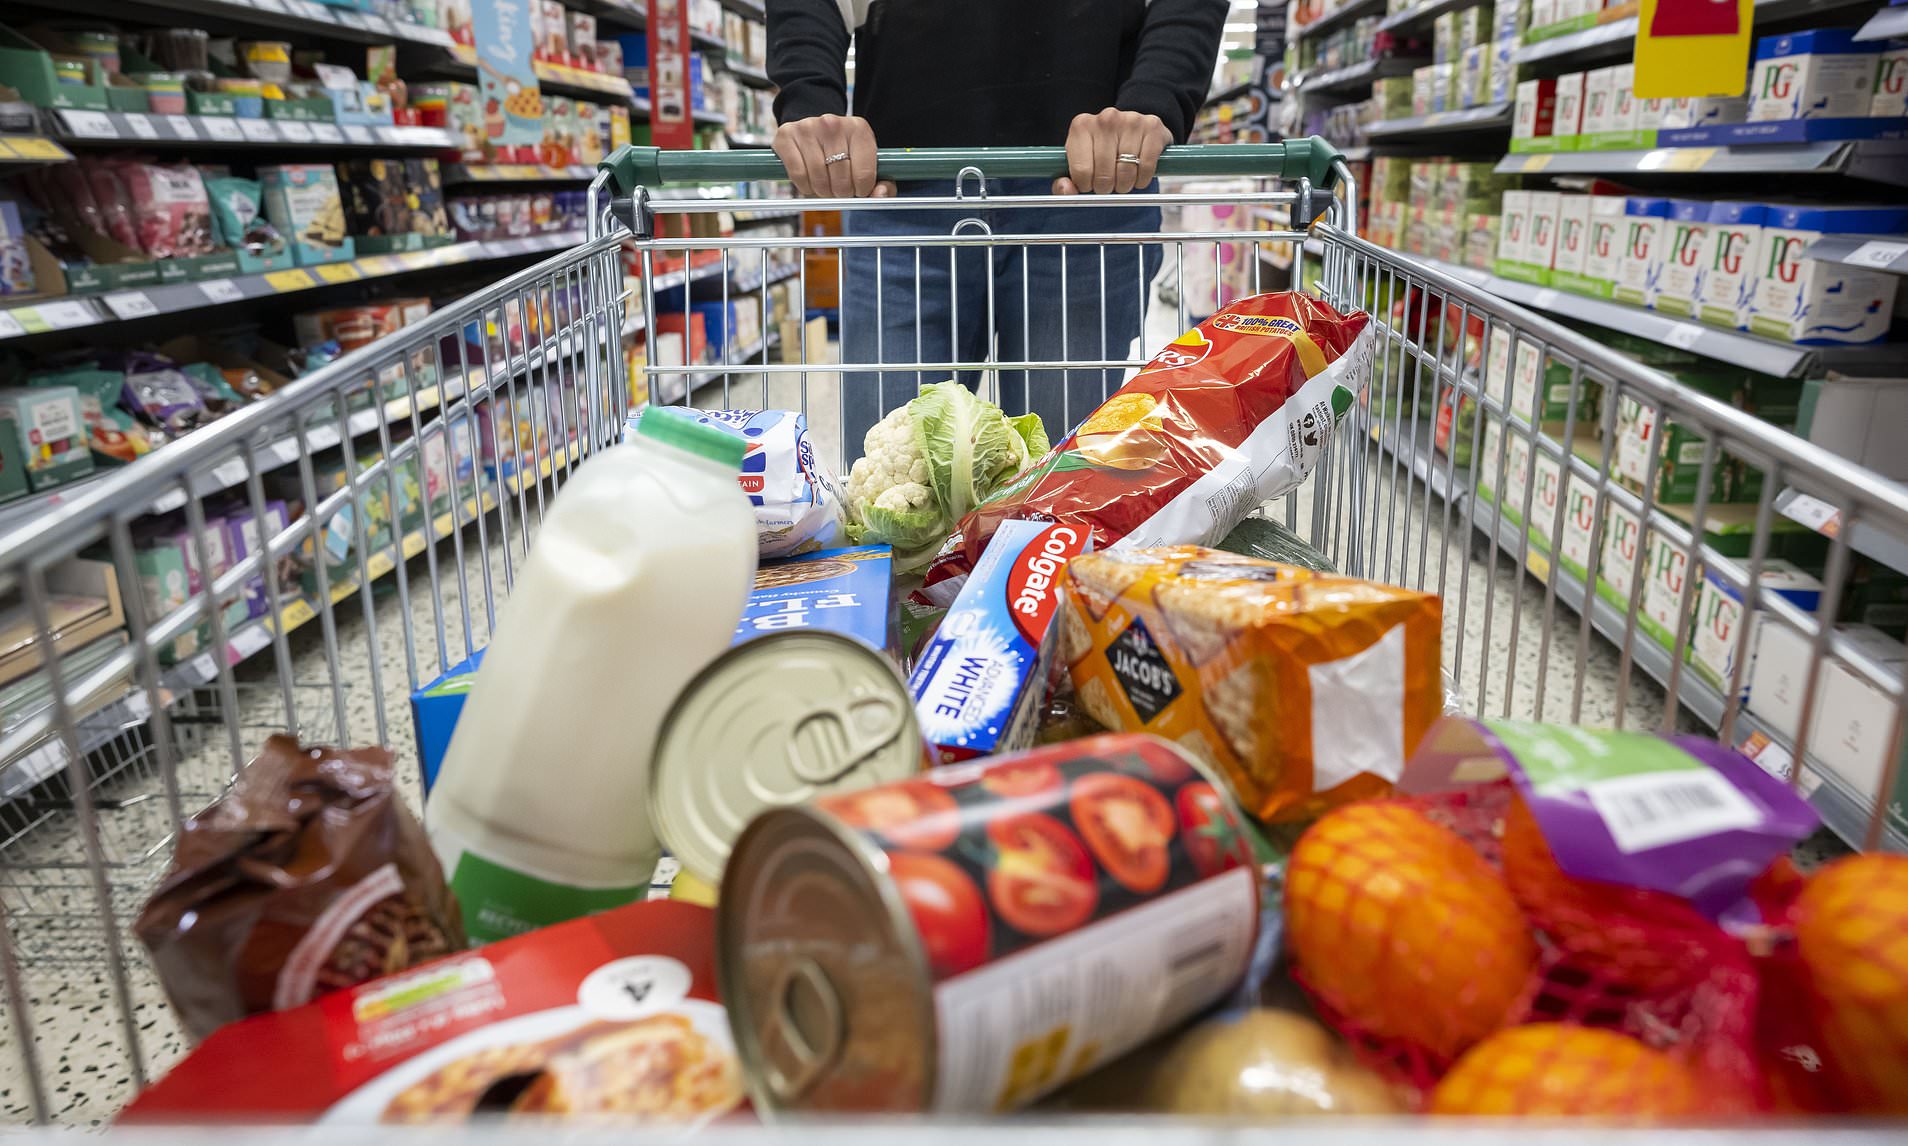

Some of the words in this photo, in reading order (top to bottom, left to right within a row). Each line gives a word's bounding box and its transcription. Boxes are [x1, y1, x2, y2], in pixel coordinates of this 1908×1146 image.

[1762, 63, 1793, 100] PG
[1626, 222, 1652, 260] PG
[1669, 225, 1704, 267] PG
[1713, 230, 1744, 274] PG
[1766, 236, 1803, 283] PG
[1236, 325, 1262, 334] BRITISH
[1260, 326, 1294, 337] POTATOES
[1242, 317, 1269, 327] 100%
[1269, 319, 1300, 333] GREAT
[1569, 487, 1593, 531] PG
[1612, 513, 1638, 561] PG
[1013, 526, 1078, 615] Colgate
[1656, 542, 1685, 594] PG
[1704, 591, 1733, 641] PG
[935, 655, 989, 720] WHITE
[962, 658, 1003, 724] ADVANCED
[1113, 649, 1173, 696] JACOB'S
